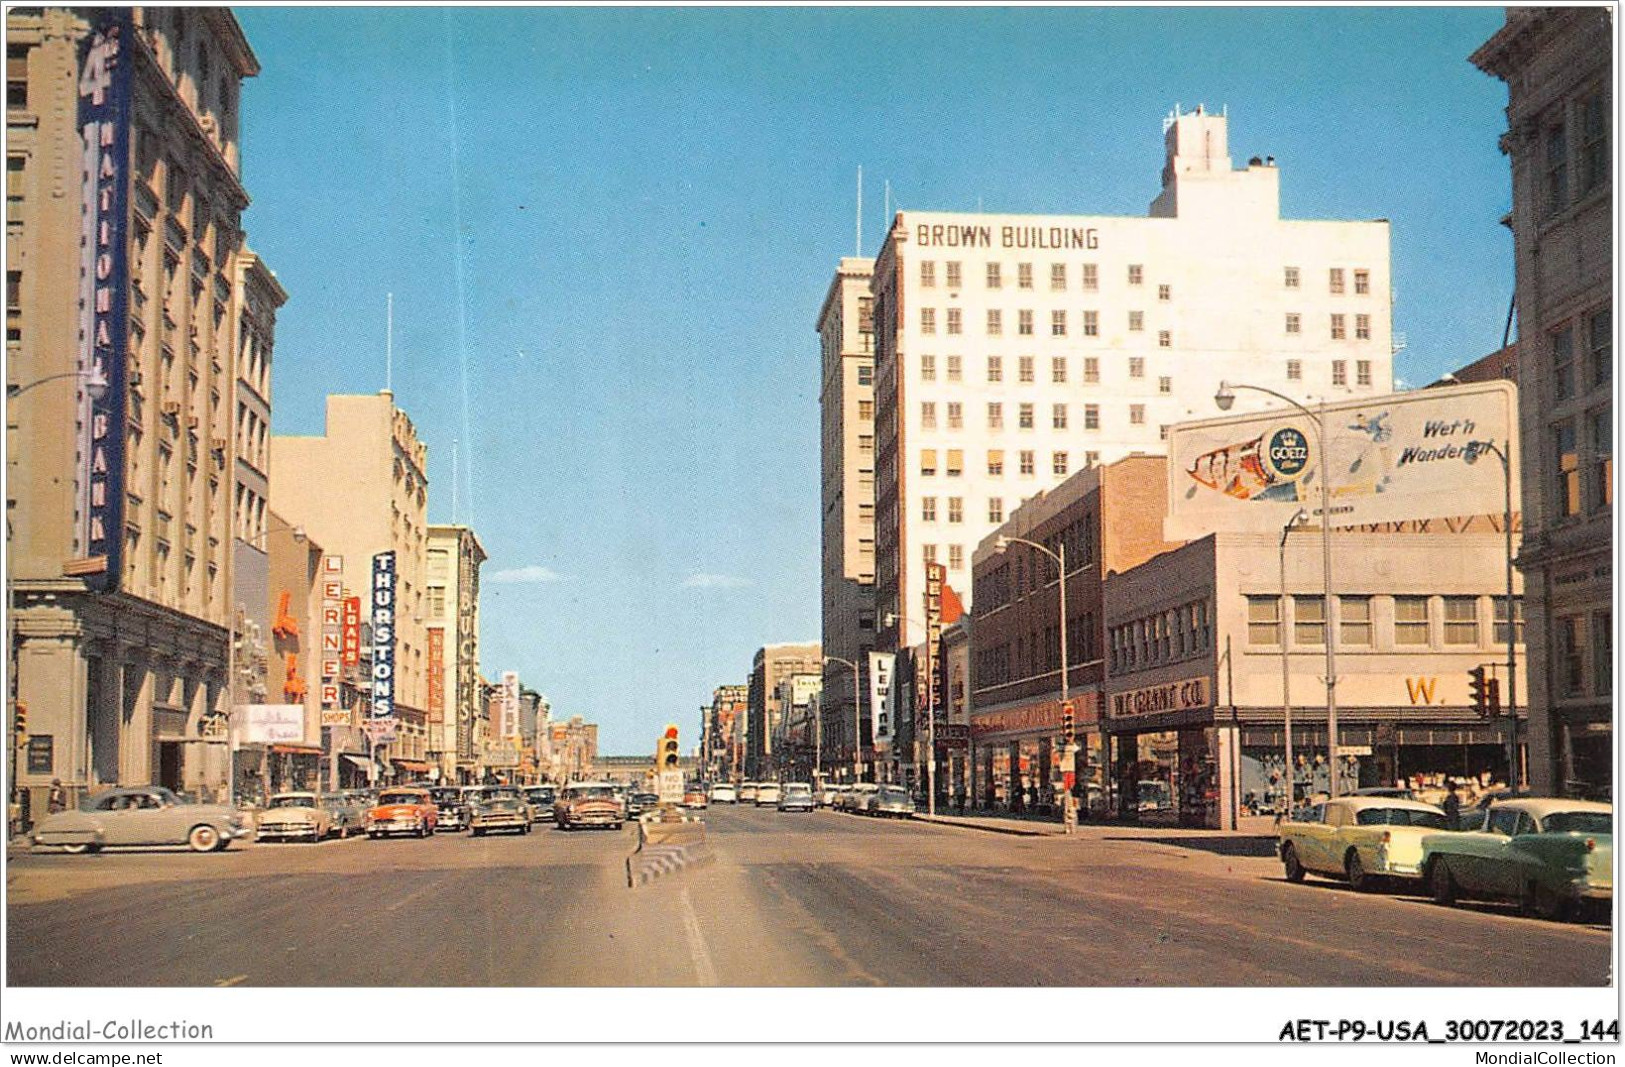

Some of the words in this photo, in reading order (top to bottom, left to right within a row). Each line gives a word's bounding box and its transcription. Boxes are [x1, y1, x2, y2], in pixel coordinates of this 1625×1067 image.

[917, 224, 991, 247] BROWN
[1001, 226, 1099, 249] BUILDING
[1271, 447, 1307, 460] GOETZ
[90, 414, 107, 540] BANK
[324, 558, 339, 699] LERNER
[345, 601, 357, 661] LOANS
[374, 555, 391, 715] THURSTONS
[1405, 677, 1445, 704] W.
[323, 713, 350, 724] SHOPS
